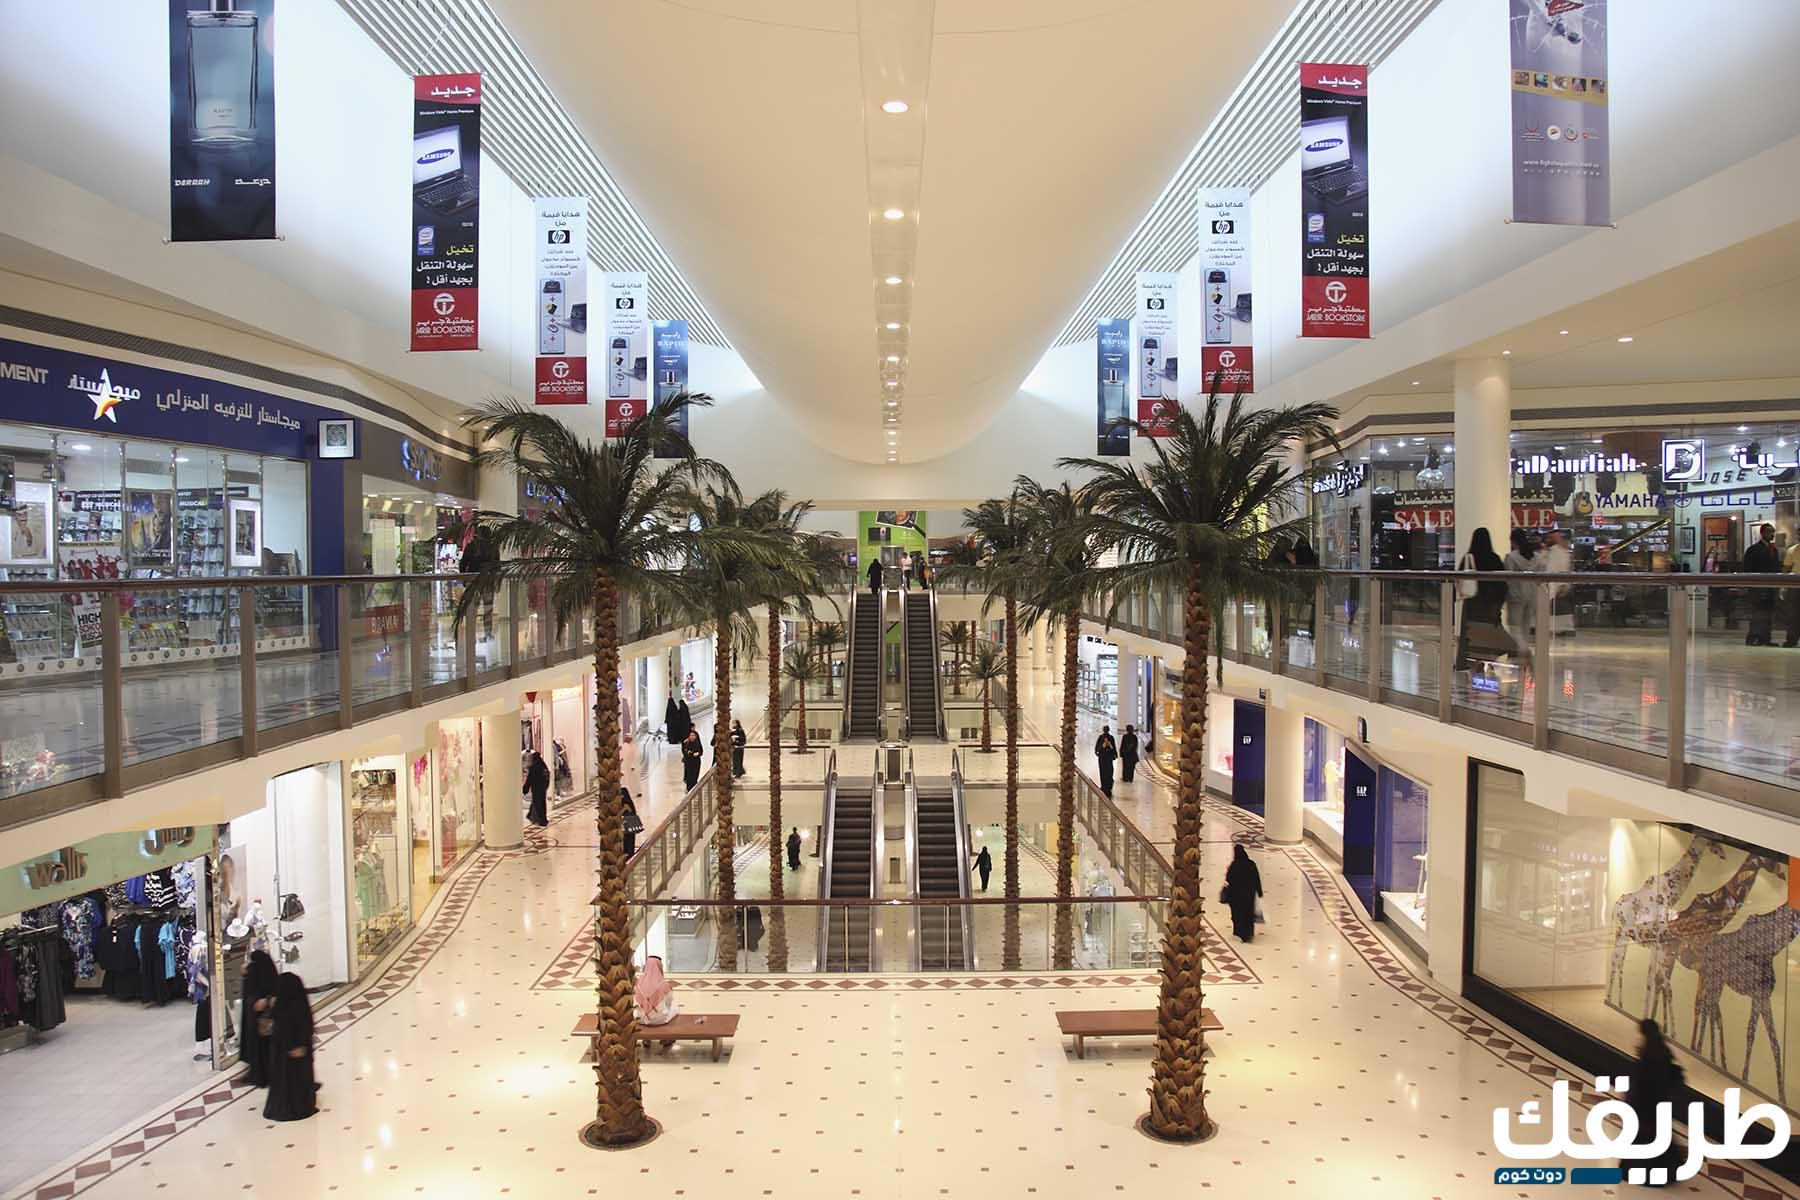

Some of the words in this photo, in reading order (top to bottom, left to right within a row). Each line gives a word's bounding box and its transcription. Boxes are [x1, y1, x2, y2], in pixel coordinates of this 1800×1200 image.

[1317, 75, 1362, 88] جديد
[430, 85, 476, 97] جديد
[1307, 248, 1335, 259] التنقل
[1338, 248, 1364, 260] سهولة
[416, 260, 445, 272] التنقل
[446, 260, 473, 271] سهولة
[1340, 265, 1364, 275] بجهد
[450, 275, 473, 285] بجهد
[1338, 305, 1365, 313] مكتبة
[1325, 313, 1365, 322] BOOKSTORE
[433, 326, 474, 334] BOOKSTORE
[156, 389, 209, 412] المنزلي
[214, 402, 252, 421] للترفيه
[257, 406, 300, 430] ميجاستار
[1704, 470, 1747, 485] OSE
[1393, 490, 1454, 507] تخفيضات
[1595, 494, 1667, 508] YAMAHA
[1394, 510, 1454, 529] SALE
[1511, 509, 1554, 528] ALE
[78, 612, 101, 625] HIGH
